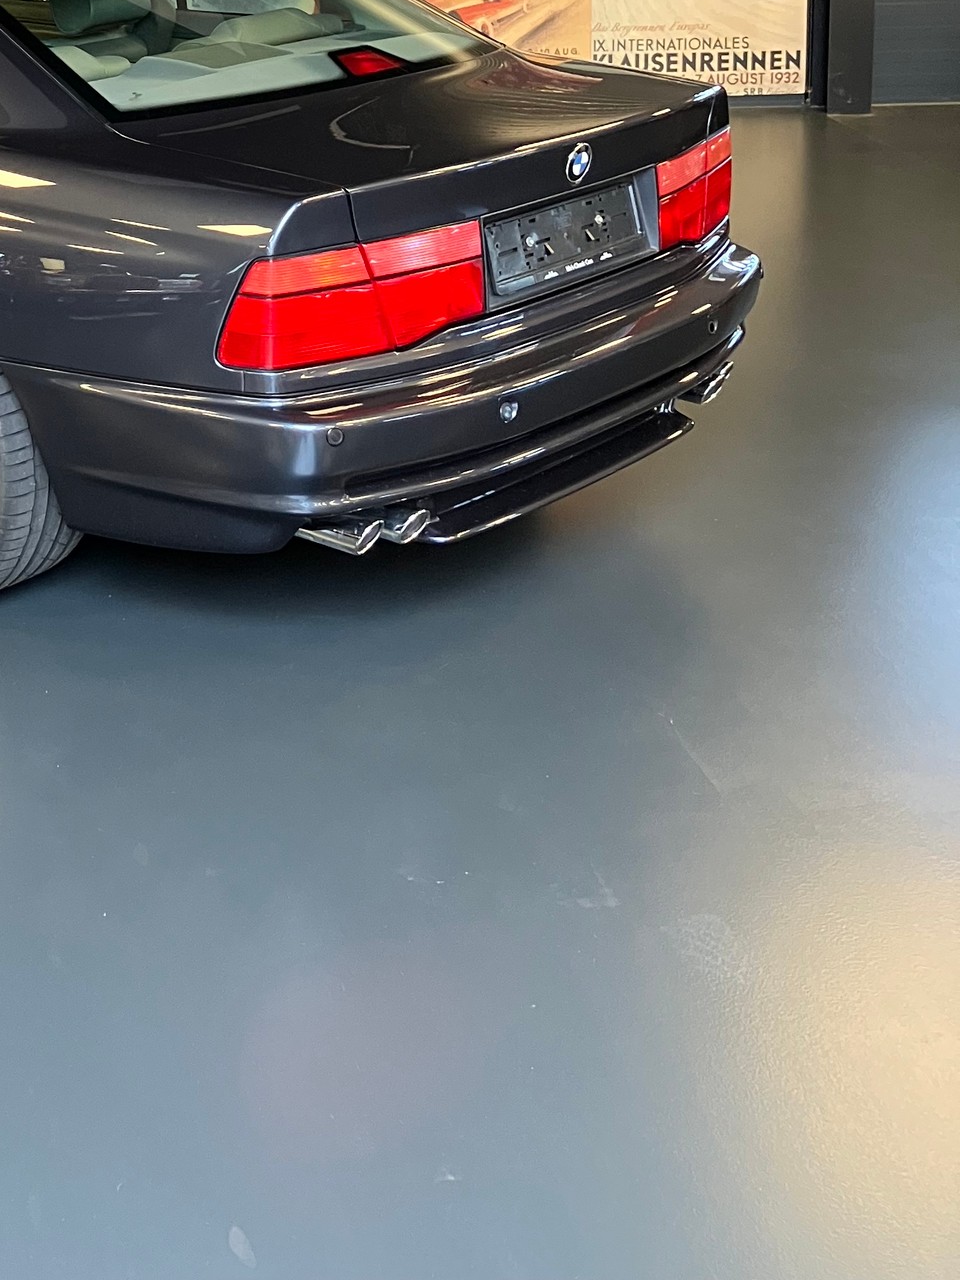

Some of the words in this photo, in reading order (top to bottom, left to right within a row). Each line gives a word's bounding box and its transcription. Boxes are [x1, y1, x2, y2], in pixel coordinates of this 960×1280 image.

[612, 36, 750, 51] INTERNATIONALES
[707, 73, 766, 85] AUGUST
[770, 72, 800, 84] 1932
